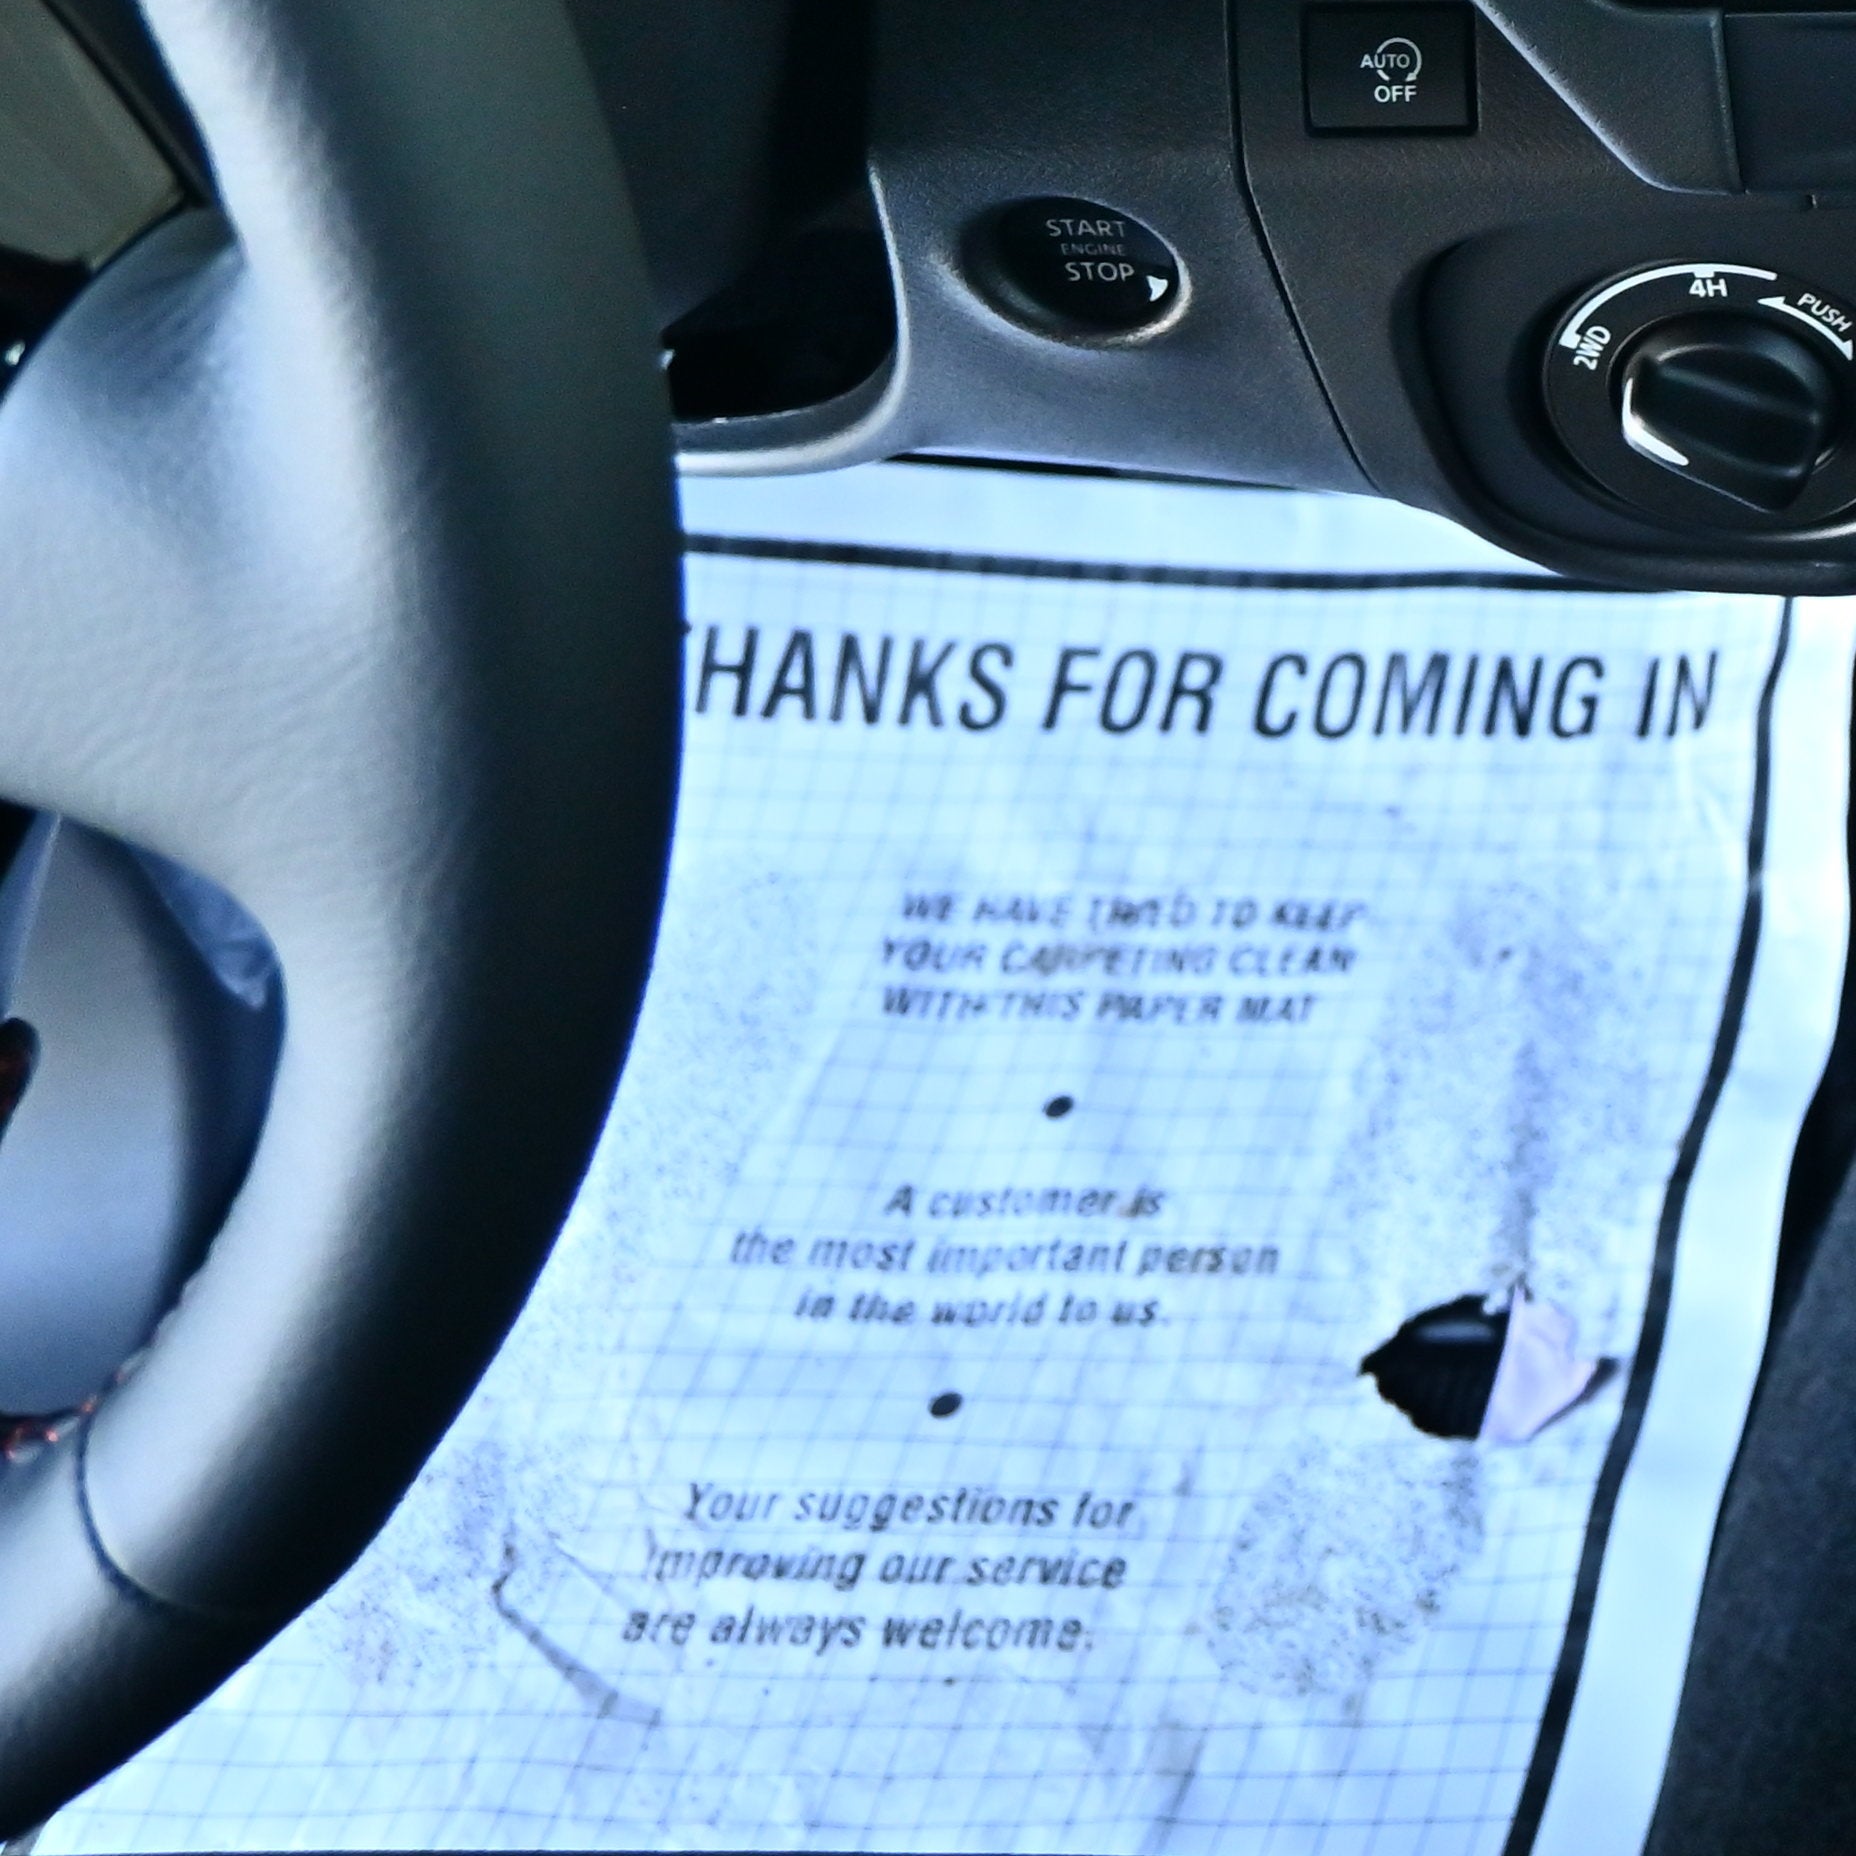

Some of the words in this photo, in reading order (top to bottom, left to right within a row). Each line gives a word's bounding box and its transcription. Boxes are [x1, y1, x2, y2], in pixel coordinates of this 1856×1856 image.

[1359, 53, 1411, 69] AUTO
[1374, 85, 1418, 104] OFF
[1045, 218, 1127, 238] START
[1060, 242, 1126, 257] ENGINE
[1065, 261, 1136, 282] STOP
[1689, 278, 1728, 298] 4H
[1796, 291, 1854, 334] PUSH
[1572, 324, 1612, 371] 2WD
[684, 624, 1014, 733] HANKS
[1041, 645, 1226, 735] FOR
[1252, 650, 1606, 739] COMING
[1635, 649, 1719, 739] IN
[885, 1184, 915, 1218] A
[730, 1227, 795, 1266] the
[807, 1236, 914, 1272] most
[926, 1237, 1128, 1278] important
[847, 1288, 916, 1326] the
[684, 1482, 779, 1523] Your
[794, 1486, 1060, 1532] suggestions
[1072, 1490, 1138, 1531] for
[877, 1550, 955, 1587] our
[964, 1549, 1129, 1591] service
[621, 1608, 697, 1646] are
[708, 1605, 867, 1658] always
